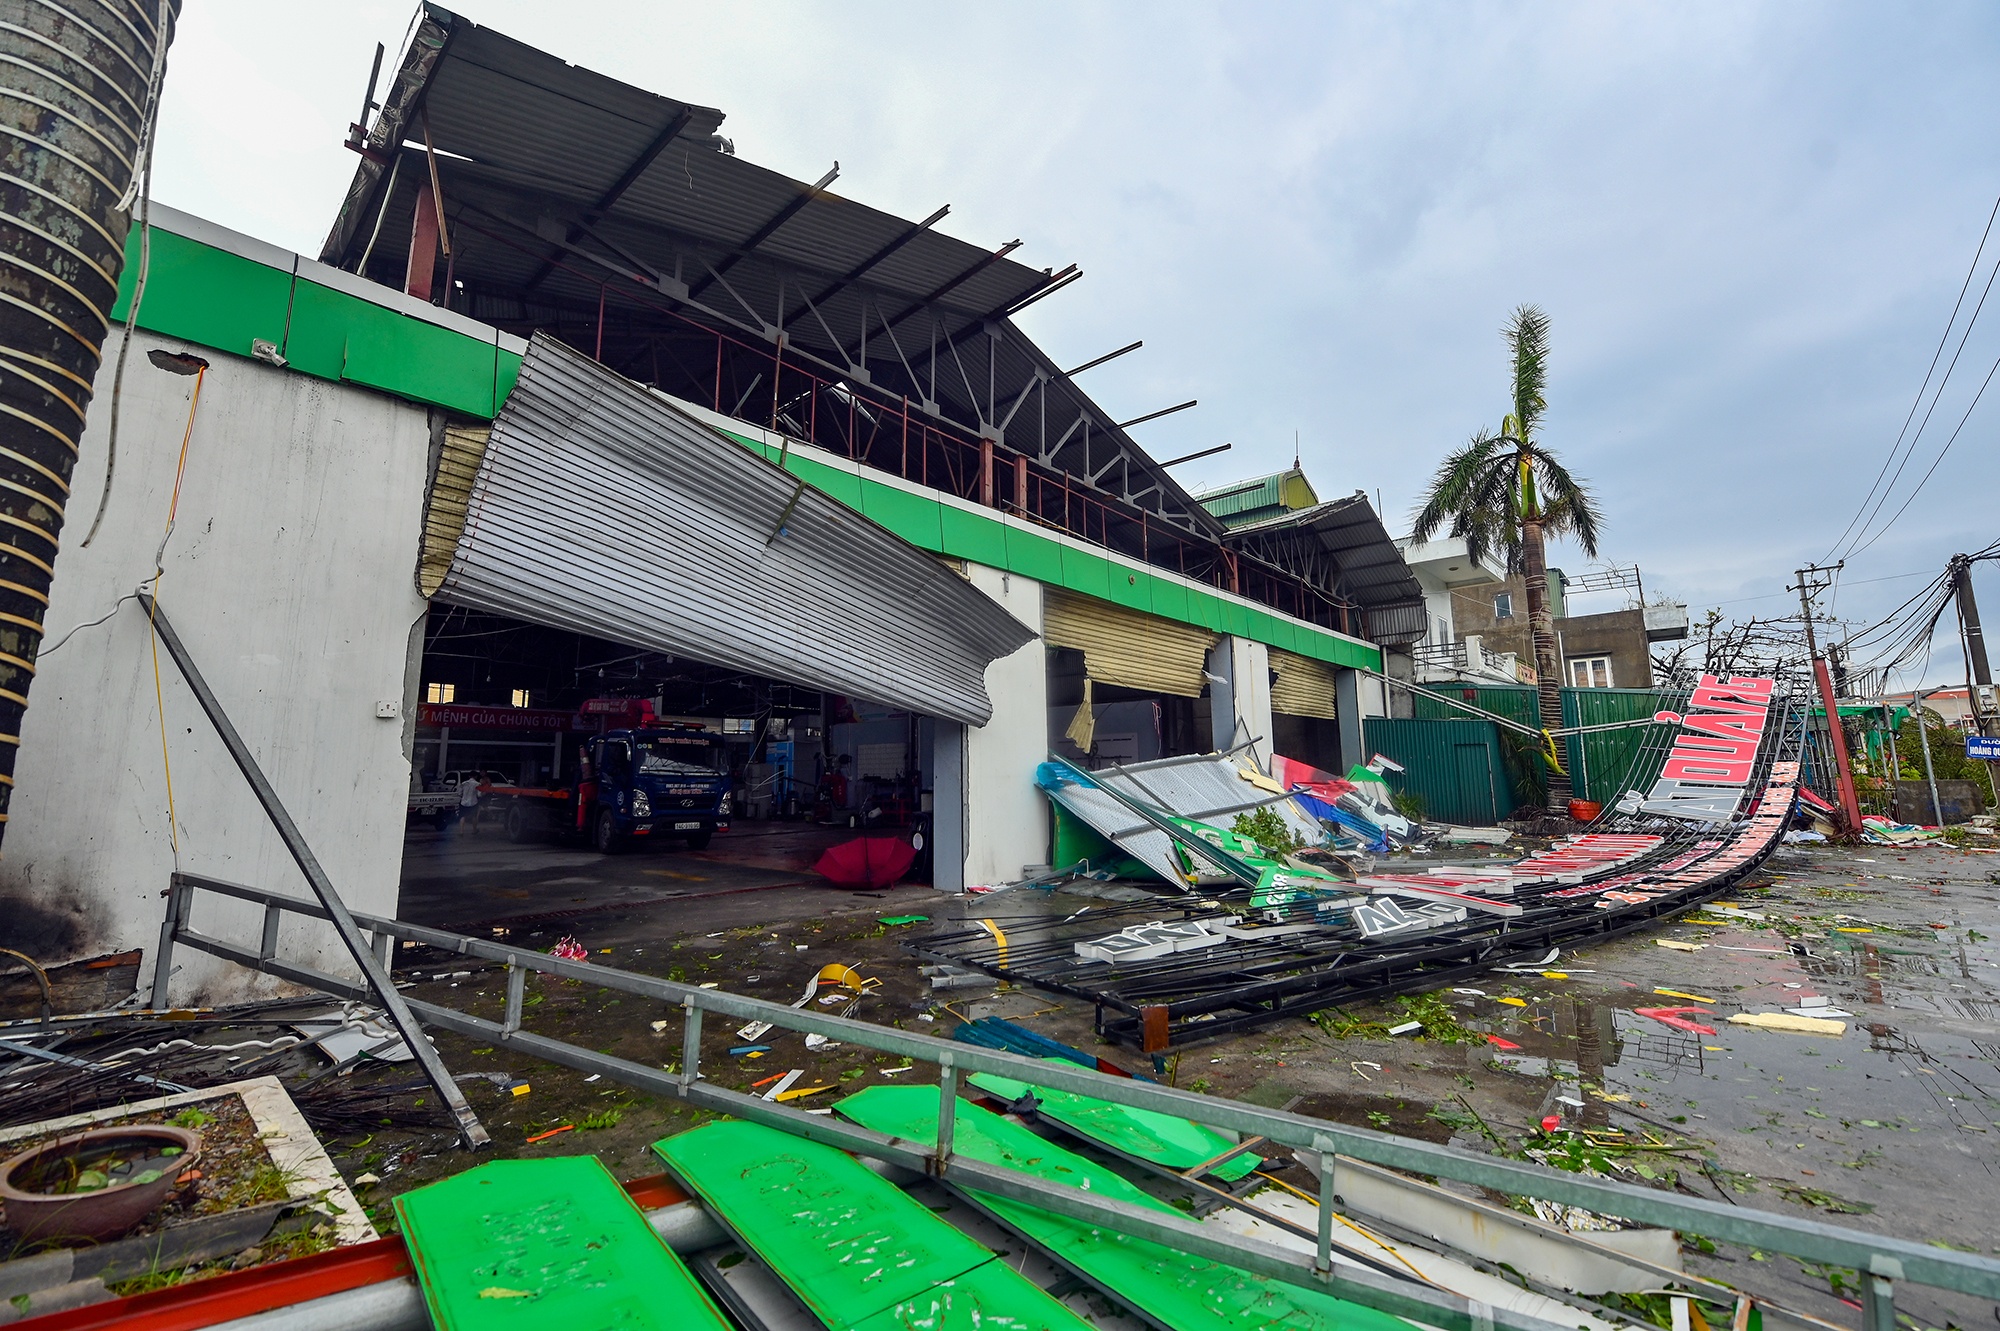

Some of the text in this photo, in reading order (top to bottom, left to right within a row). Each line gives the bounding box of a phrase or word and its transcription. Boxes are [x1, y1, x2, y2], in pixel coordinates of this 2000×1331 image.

[431, 709, 468, 725] MỆNH
[470, 710, 495, 725] CỦA
[499, 712, 540, 727] CHÚNG
[1653, 674, 1776, 785] QUẢNG
[1969, 745, 1992, 756] HOÀNG
